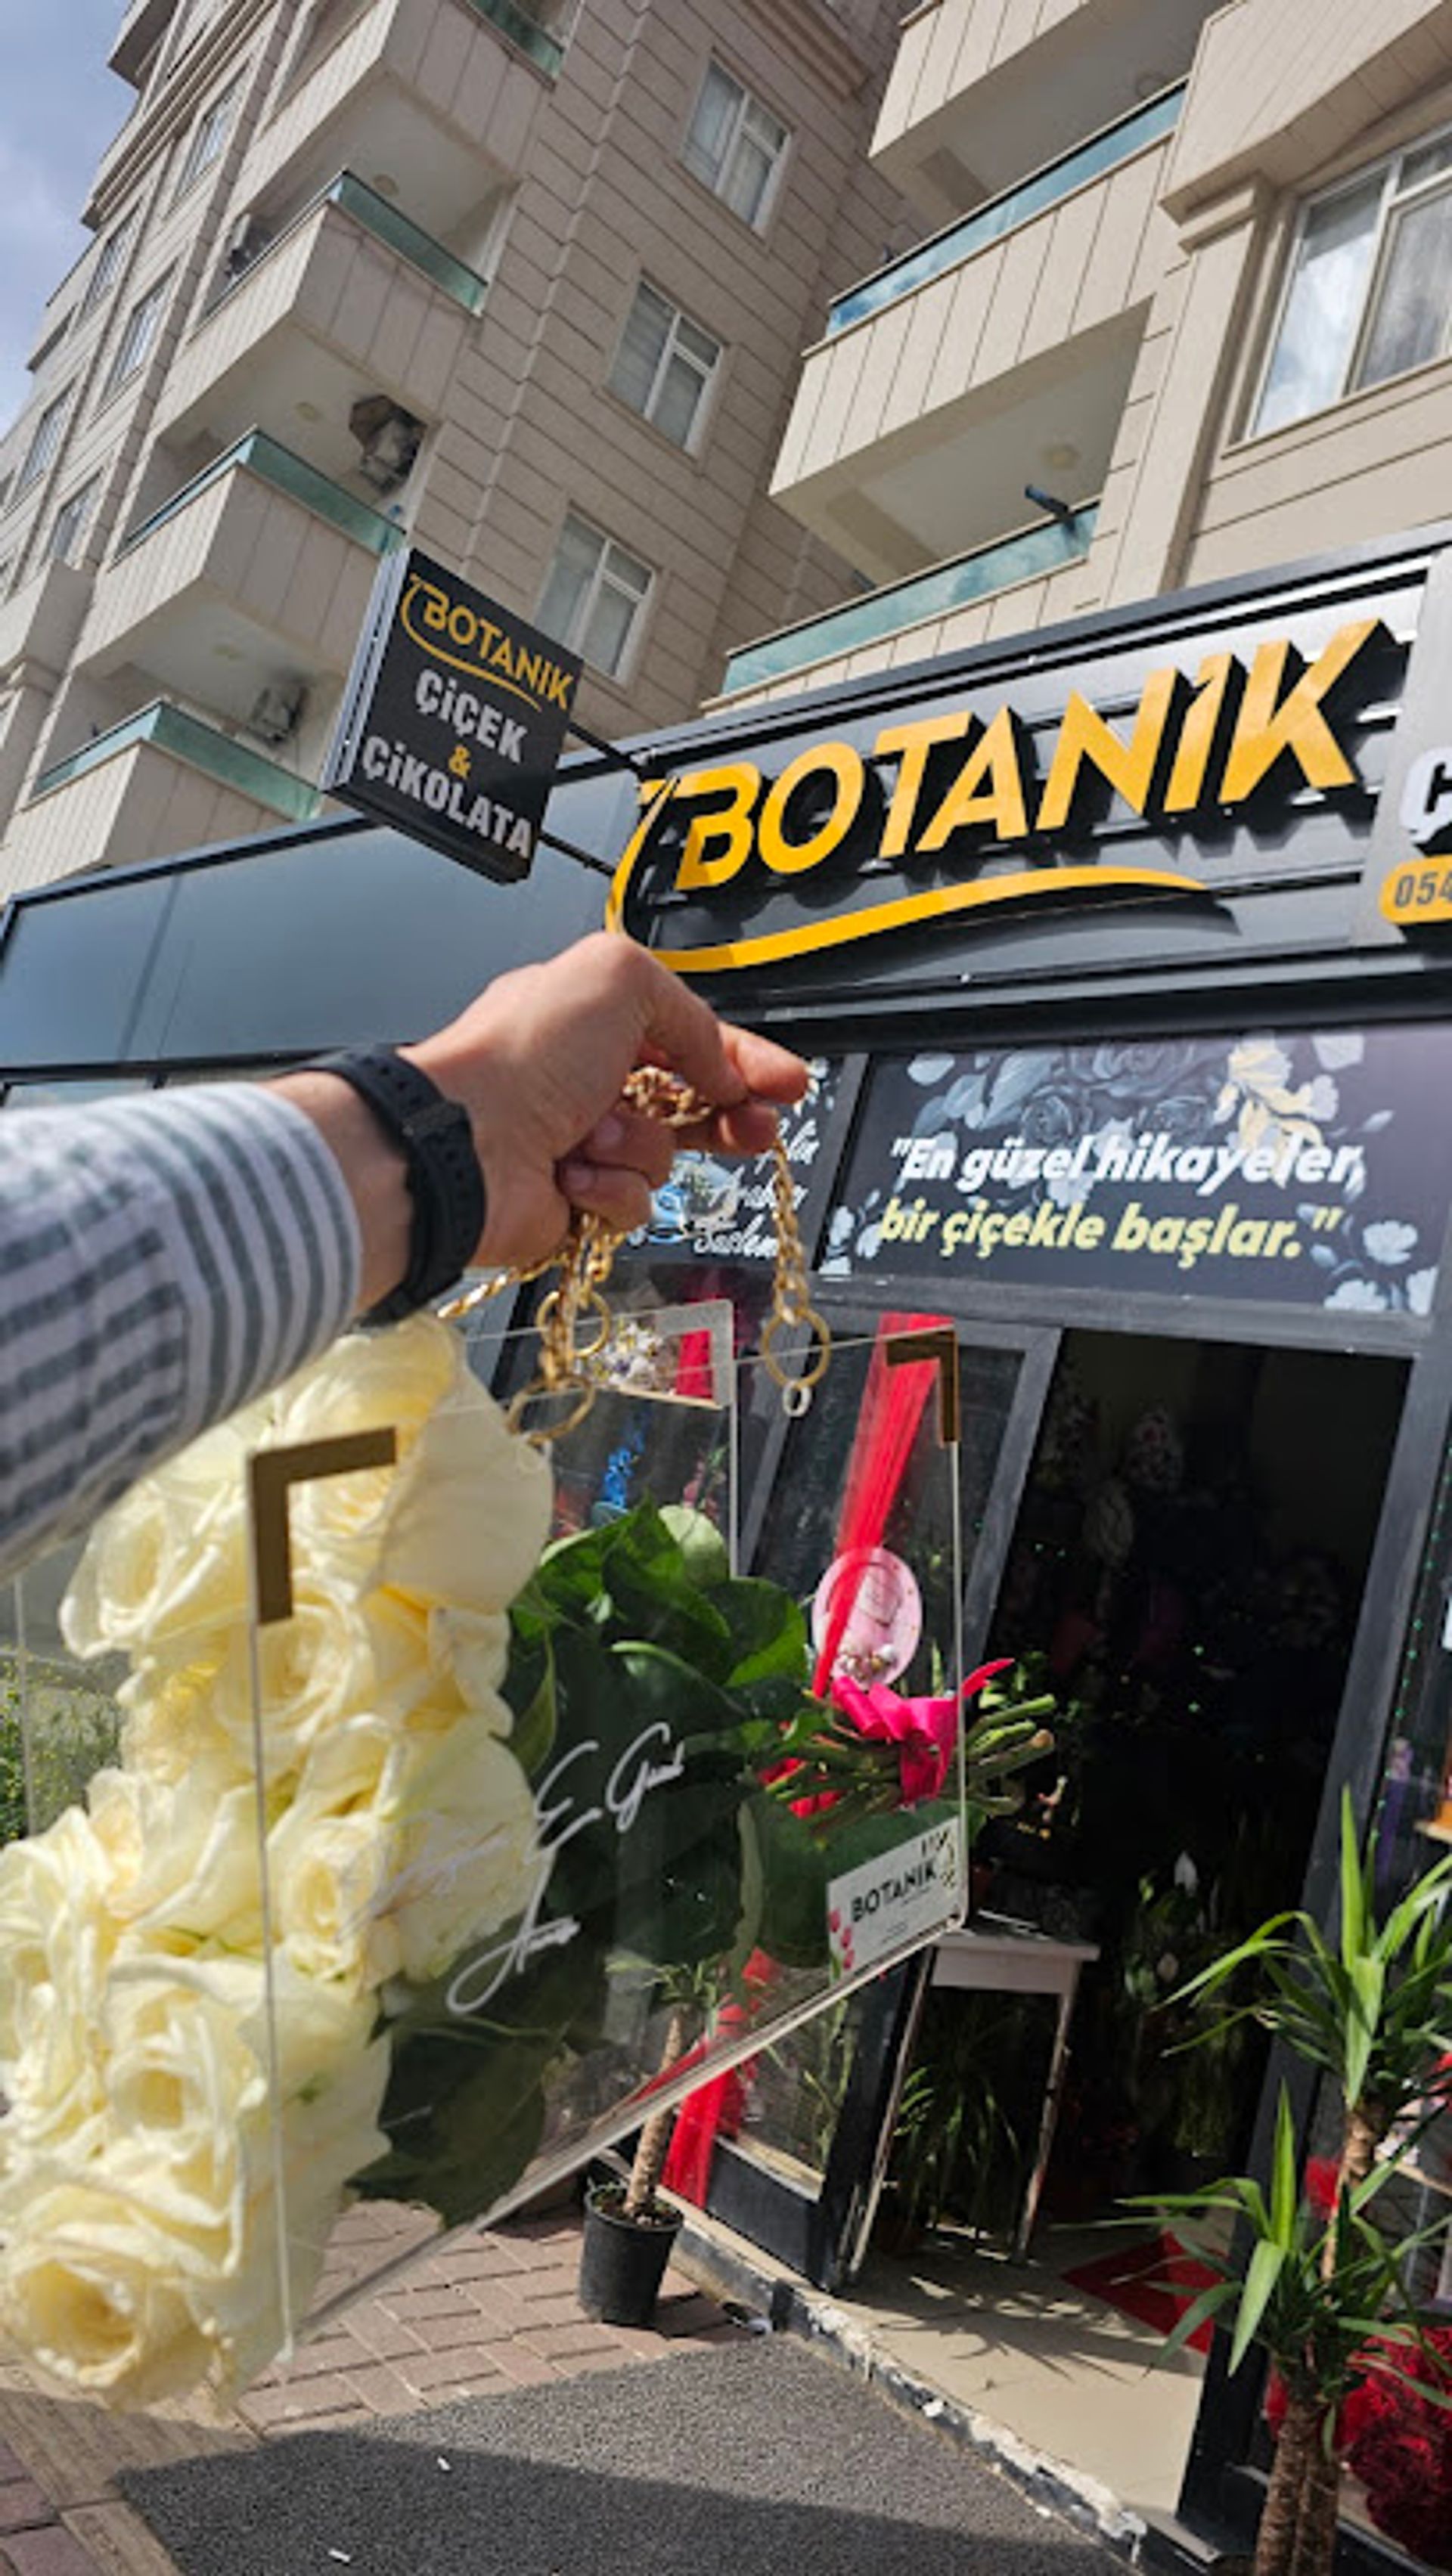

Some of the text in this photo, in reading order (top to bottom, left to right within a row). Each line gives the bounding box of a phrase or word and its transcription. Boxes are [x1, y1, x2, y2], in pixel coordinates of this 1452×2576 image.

[448, 745, 472, 779] &
[954, 1134, 1097, 1194] güzel
[879, 1196, 939, 1243] bir
[939, 1198, 1106, 1258] çiçekle
